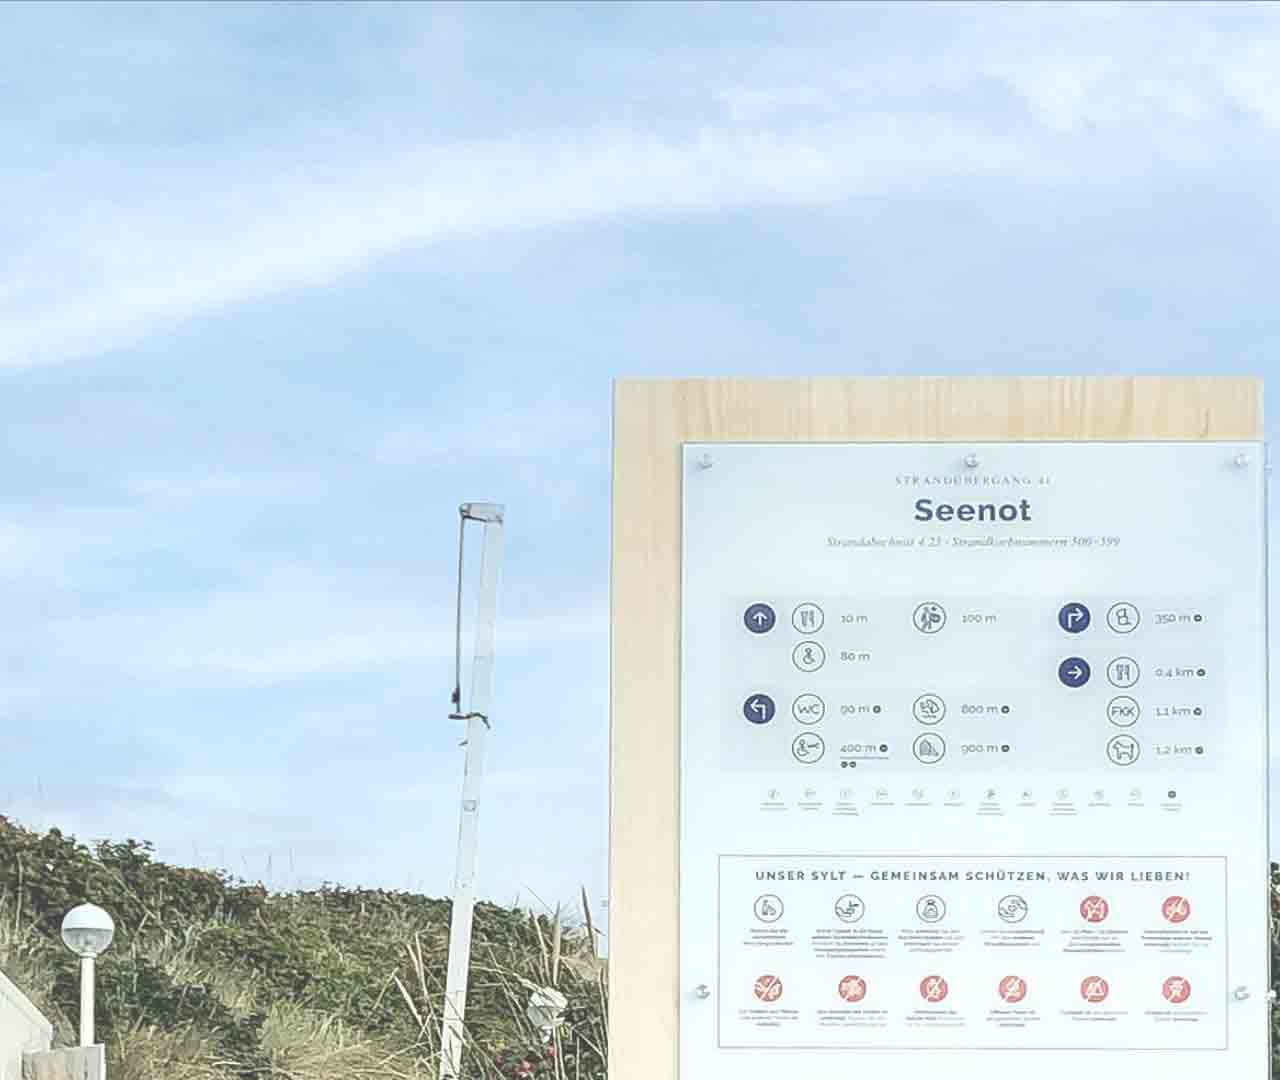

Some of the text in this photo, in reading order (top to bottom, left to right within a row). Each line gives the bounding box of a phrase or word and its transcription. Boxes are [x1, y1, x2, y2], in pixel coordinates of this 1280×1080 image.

[914, 498, 1032, 521] Seenot
[857, 615, 868, 624] m
[961, 613, 997, 624] 100 m
[1179, 615, 1191, 623] m
[858, 652, 871, 662] m
[1176, 667, 1194, 677] km
[797, 703, 820, 715] WC
[986, 705, 998, 714] m
[1111, 705, 1136, 717] FKK
[1173, 706, 1191, 716] km
[986, 744, 998, 753] m
[755, 871, 805, 881] UNSER
[811, 871, 847, 881] SYLT
[870, 871, 959, 881] GEMEINSAM
[1057, 871, 1089, 881] WAS
[1095, 871, 1124, 881] WIR
[1130, 871, 1190, 881] LIEBEN!
